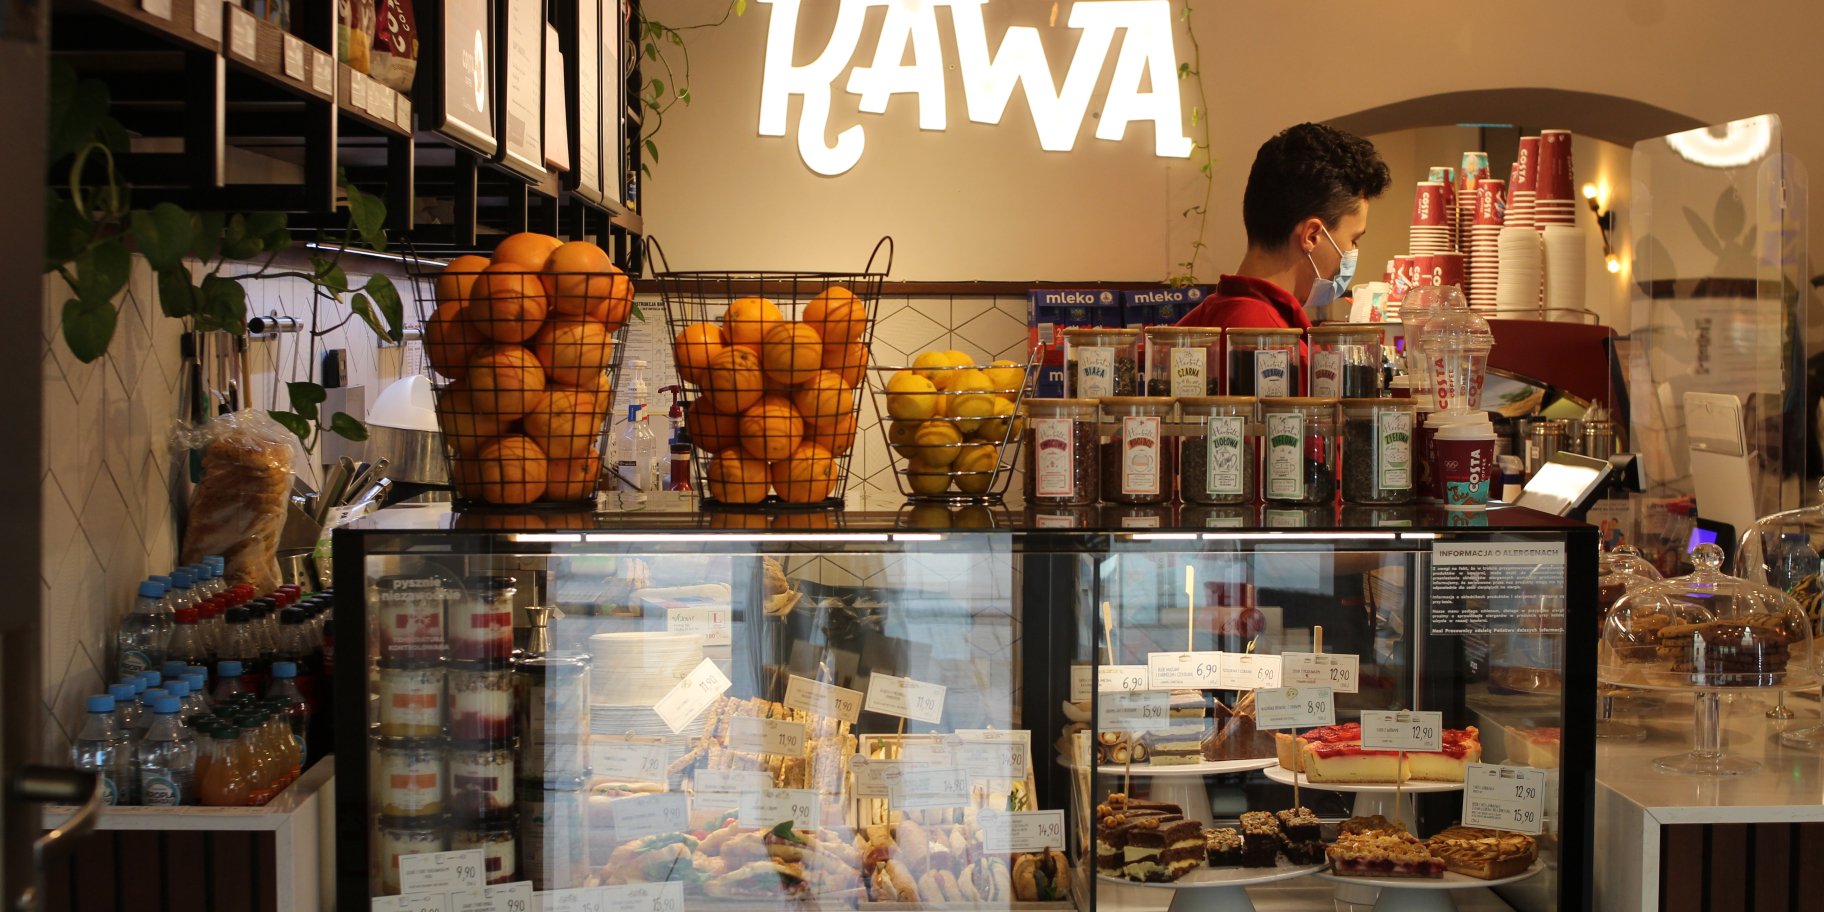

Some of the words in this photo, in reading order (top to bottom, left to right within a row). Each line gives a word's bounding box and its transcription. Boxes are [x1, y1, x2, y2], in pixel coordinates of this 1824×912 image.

[1518, 149, 1528, 184] COSTA
[1421, 192, 1430, 220] COSTA
[1482, 191, 1491, 218] COSTA
[1412, 266, 1420, 287] COS
[1432, 266, 1442, 287] CO
[1046, 292, 1095, 304] mleko
[1134, 291, 1183, 303] mleko
[1178, 367, 1200, 378] CZARNA
[1435, 358, 1448, 409] COSTA
[1213, 437, 1239, 449] ZIOŁOWA
[1385, 432, 1409, 444] ZIELONA
[1469, 449, 1481, 493] COSTA
[393, 577, 442, 590] pysznie
[381, 589, 461, 600] niezawodnie
[1196, 663, 1217, 680] 6,90
[1258, 667, 1274, 682] 6,90
[1330, 667, 1350, 683] 12,90
[1122, 676, 1143, 692] 6,90
[834, 698, 852, 712] 11,90
[917, 696, 935, 710] 11,90
[1307, 701, 1325, 715] 8,90
[1142, 704, 1162, 720] 15,90
[778, 733, 797, 748] 11,90
[1412, 725, 1433, 742] 12,90
[640, 756, 659, 772] 7,90
[1515, 785, 1536, 801] 12,90
[664, 808, 681, 823] 9,90
[792, 804, 809, 820] 9,90
[1513, 808, 1535, 824] 15,90
[1037, 822, 1060, 838] 14,90
[456, 866, 476, 882] 9,90
[652, 896, 675, 912] 15,90
